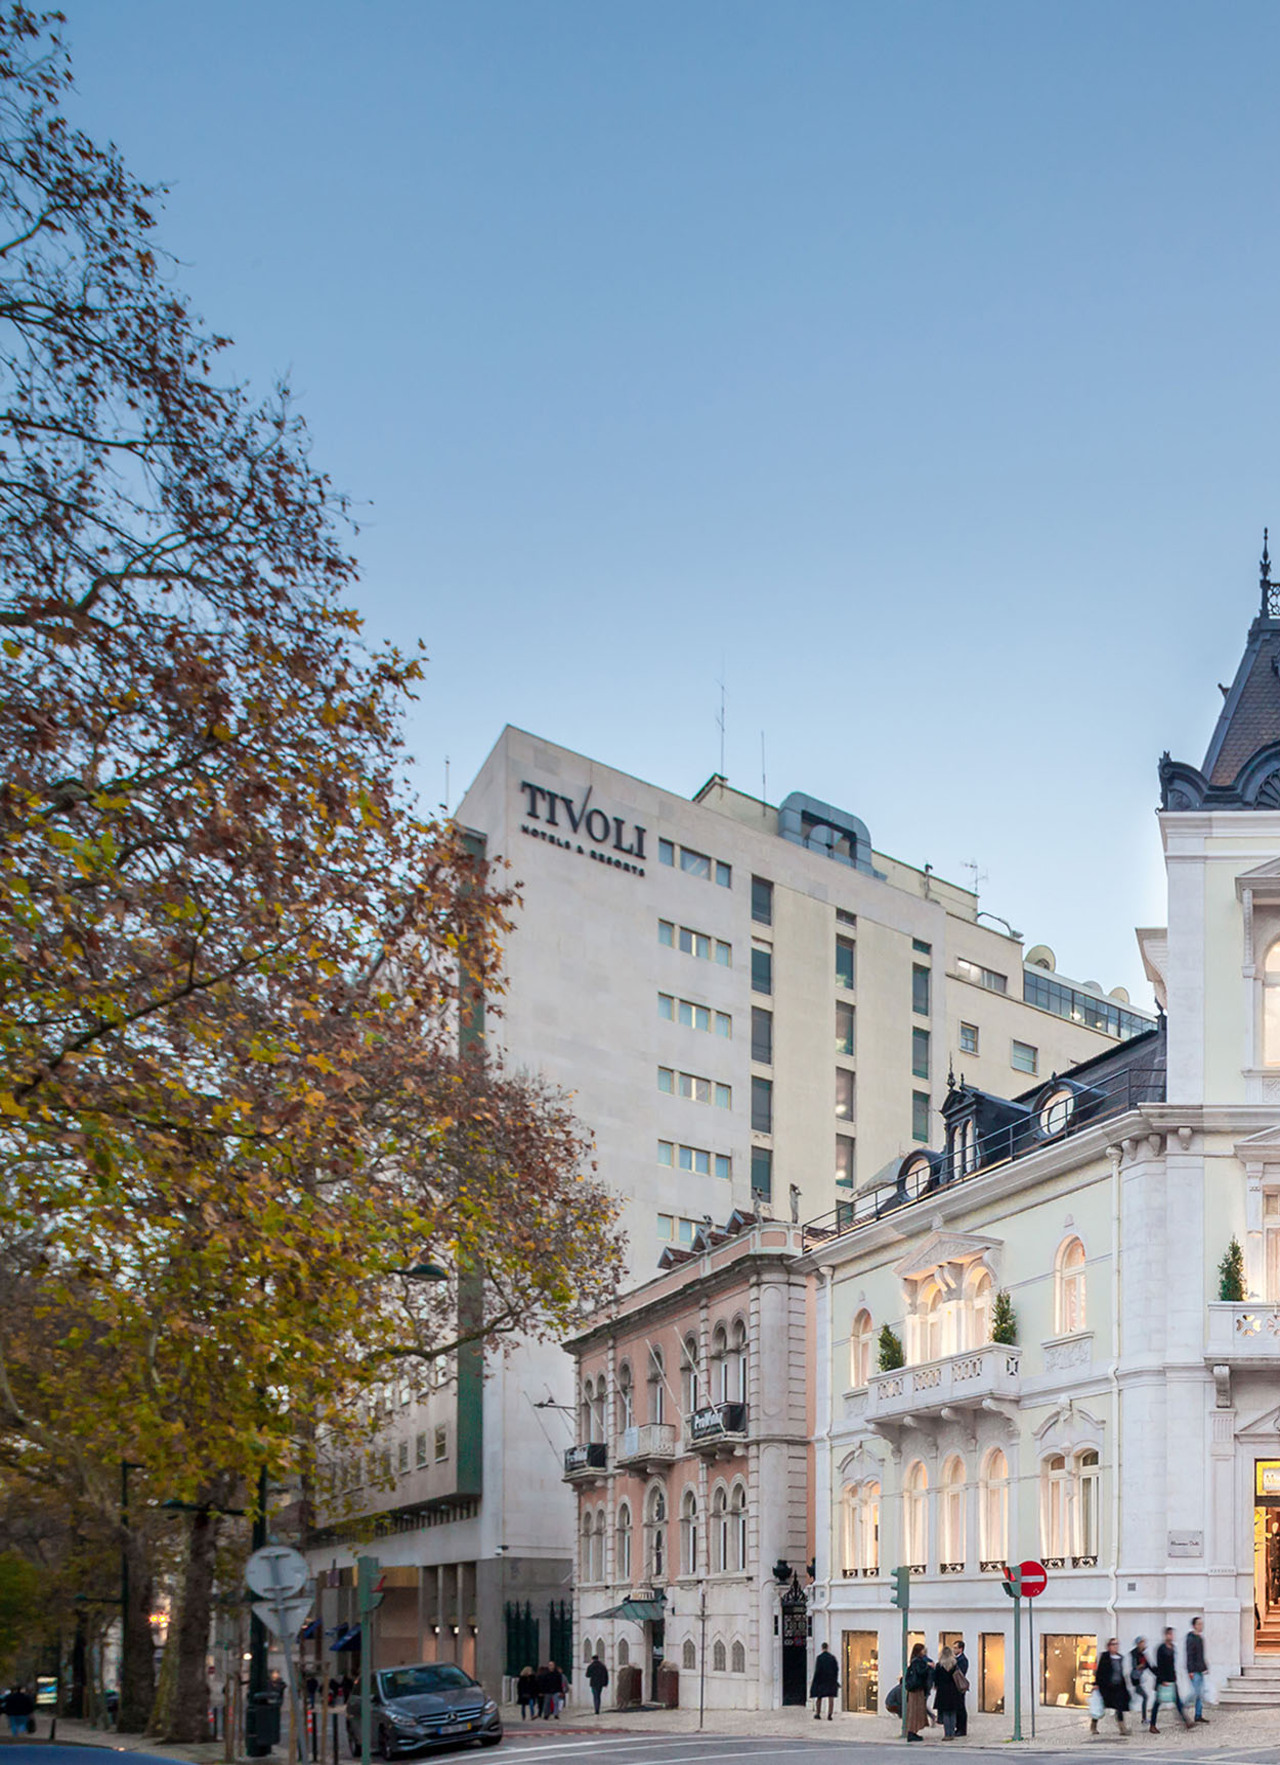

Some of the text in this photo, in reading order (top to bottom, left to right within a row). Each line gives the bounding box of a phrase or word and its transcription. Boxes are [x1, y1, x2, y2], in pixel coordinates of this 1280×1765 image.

[520, 780, 647, 860] TIVOLI
[521, 823, 645, 878] HOTELS & RESORTS
